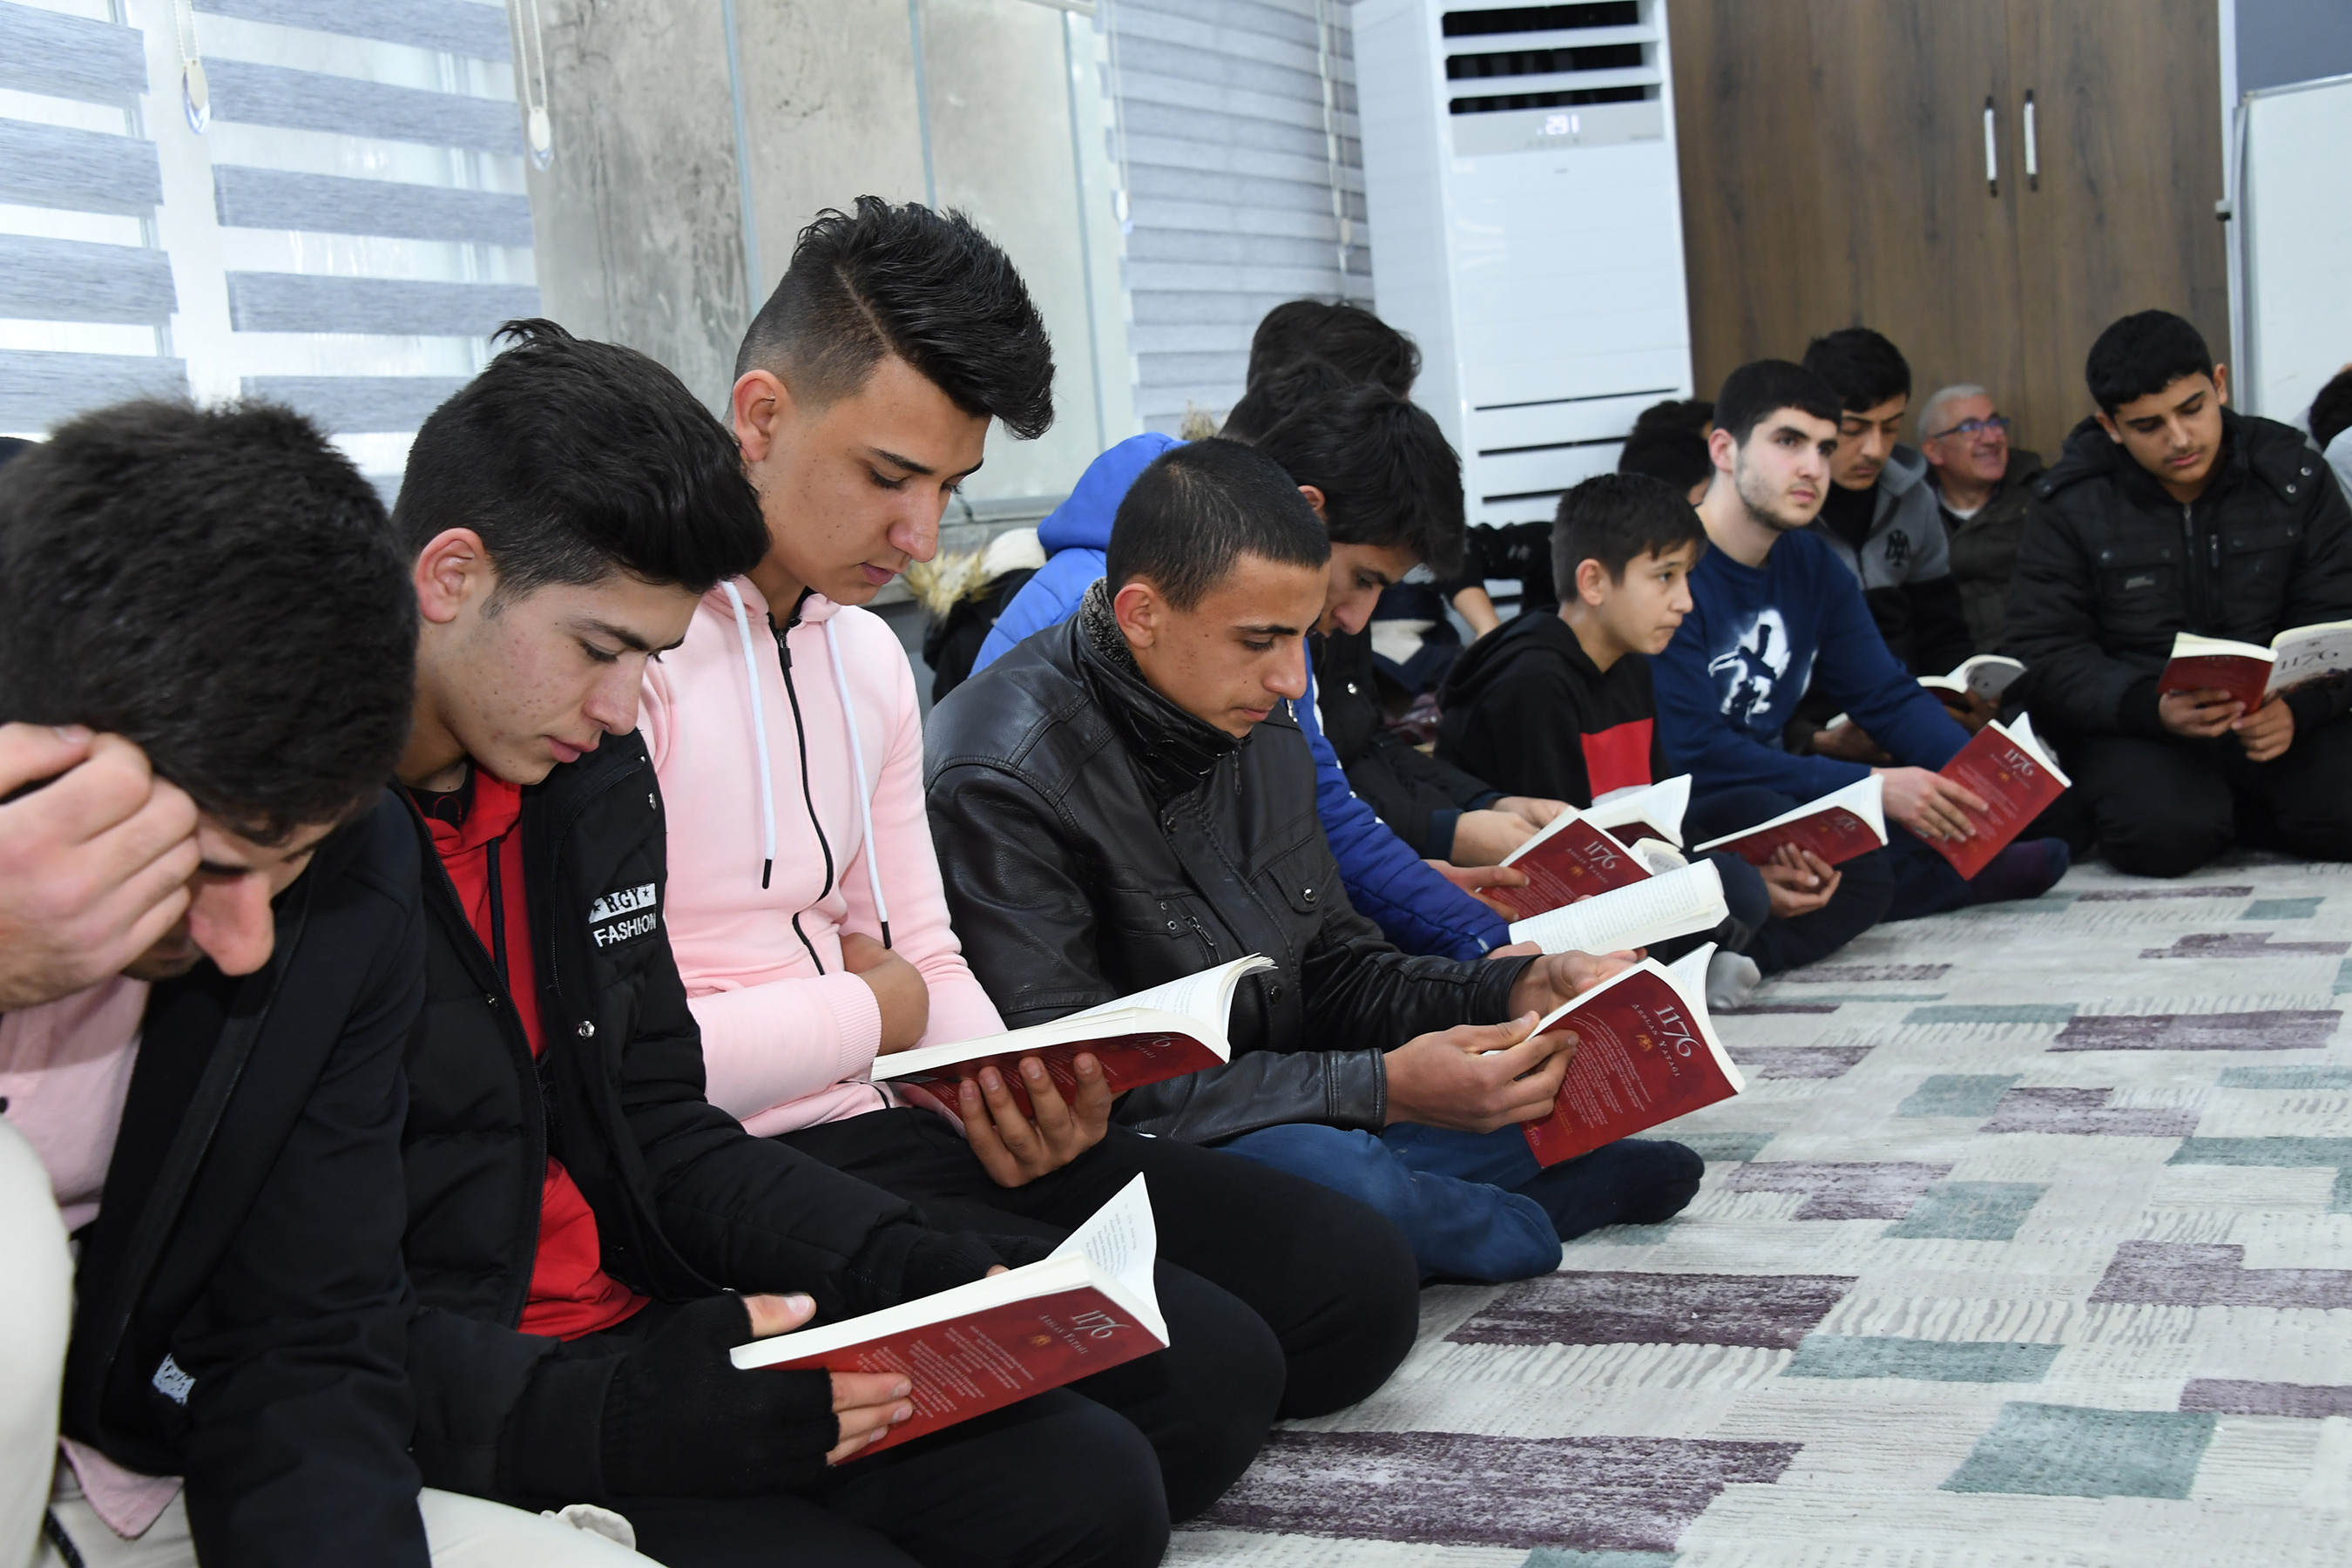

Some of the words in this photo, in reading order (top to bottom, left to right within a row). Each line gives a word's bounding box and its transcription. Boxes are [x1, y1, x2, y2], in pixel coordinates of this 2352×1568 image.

[2281, 647, 2340, 670] 1176
[2004, 748, 2036, 776] 1176
[1583, 841, 1623, 869] 1176
[592, 912, 656, 948] FASHION
[1653, 1004, 1702, 1057] 1176
[1070, 1310, 1132, 1338] 1176
